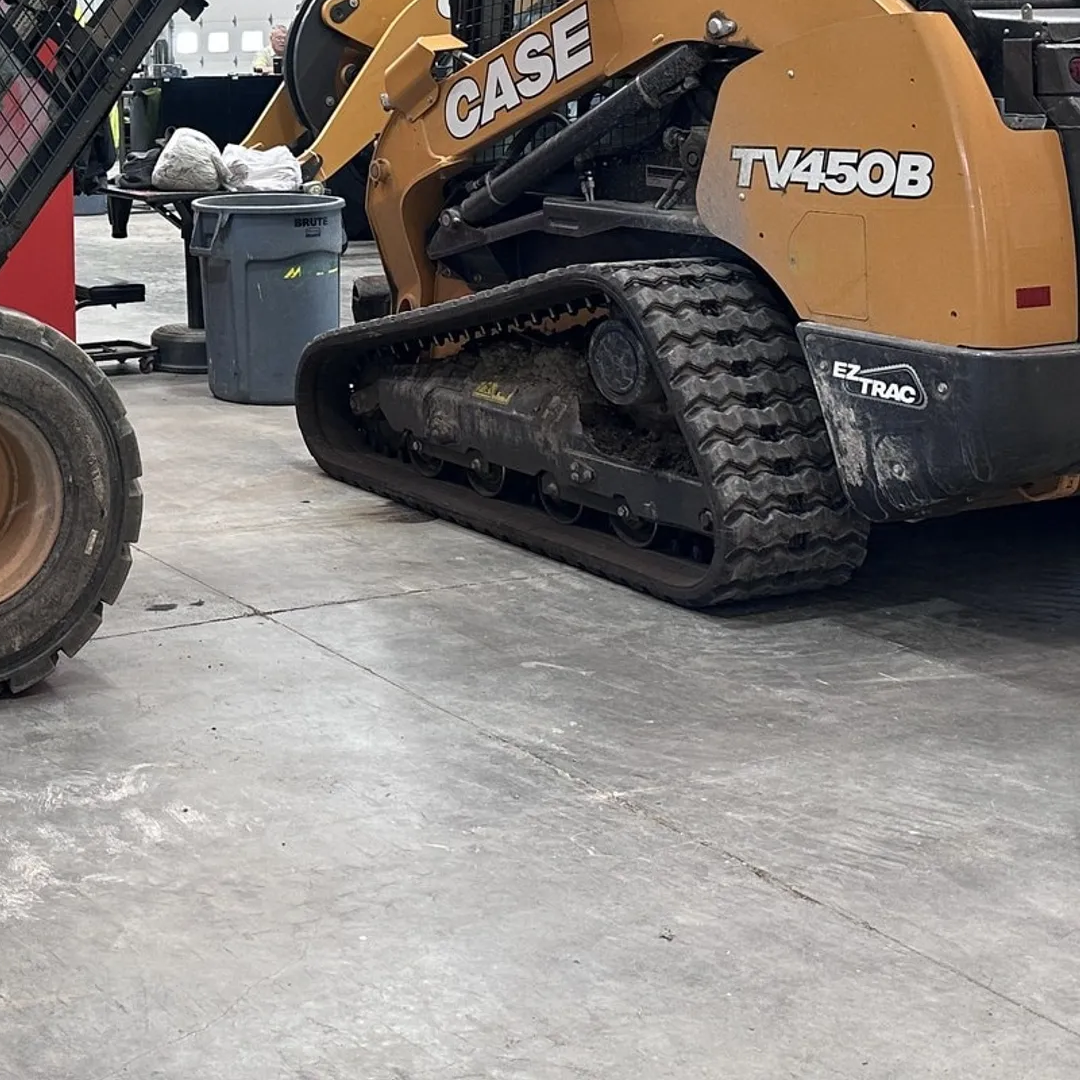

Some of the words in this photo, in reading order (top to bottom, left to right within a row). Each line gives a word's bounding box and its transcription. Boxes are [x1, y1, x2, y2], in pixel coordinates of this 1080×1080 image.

[445, 1, 593, 139] CASE
[731, 145, 935, 199] TV450B
[294, 216, 328, 228] BRUTE
[832, 360, 861, 381] EZ
[860, 377, 916, 404] TRAC
